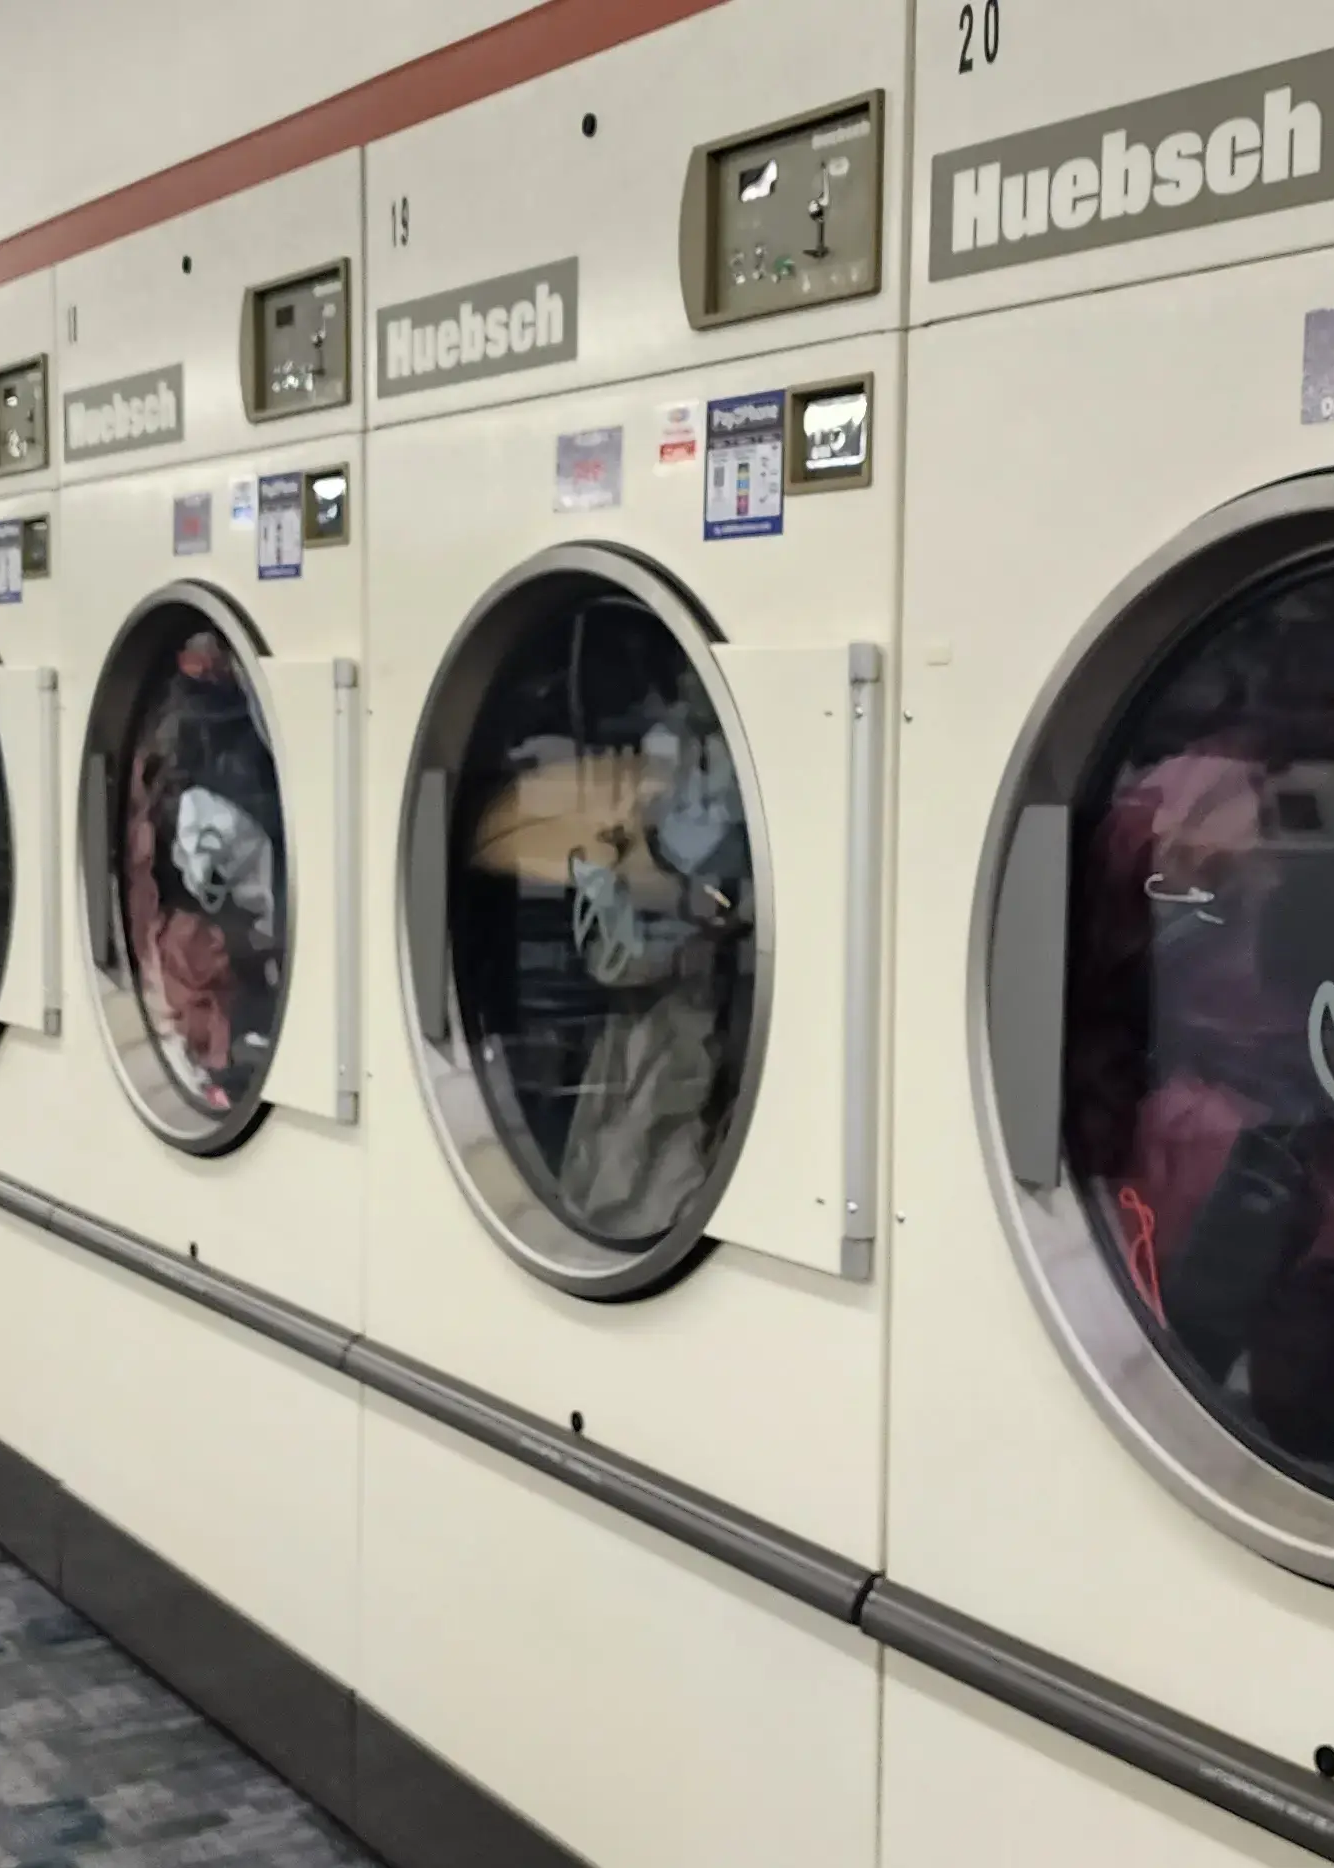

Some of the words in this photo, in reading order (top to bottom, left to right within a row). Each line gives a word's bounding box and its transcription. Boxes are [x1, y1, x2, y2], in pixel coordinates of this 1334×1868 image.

[958, 0, 1000, 74] 20
[951, 85, 1323, 254] Huebsch
[391, 196, 410, 248] 19
[386, 281, 564, 380] Huebsch
